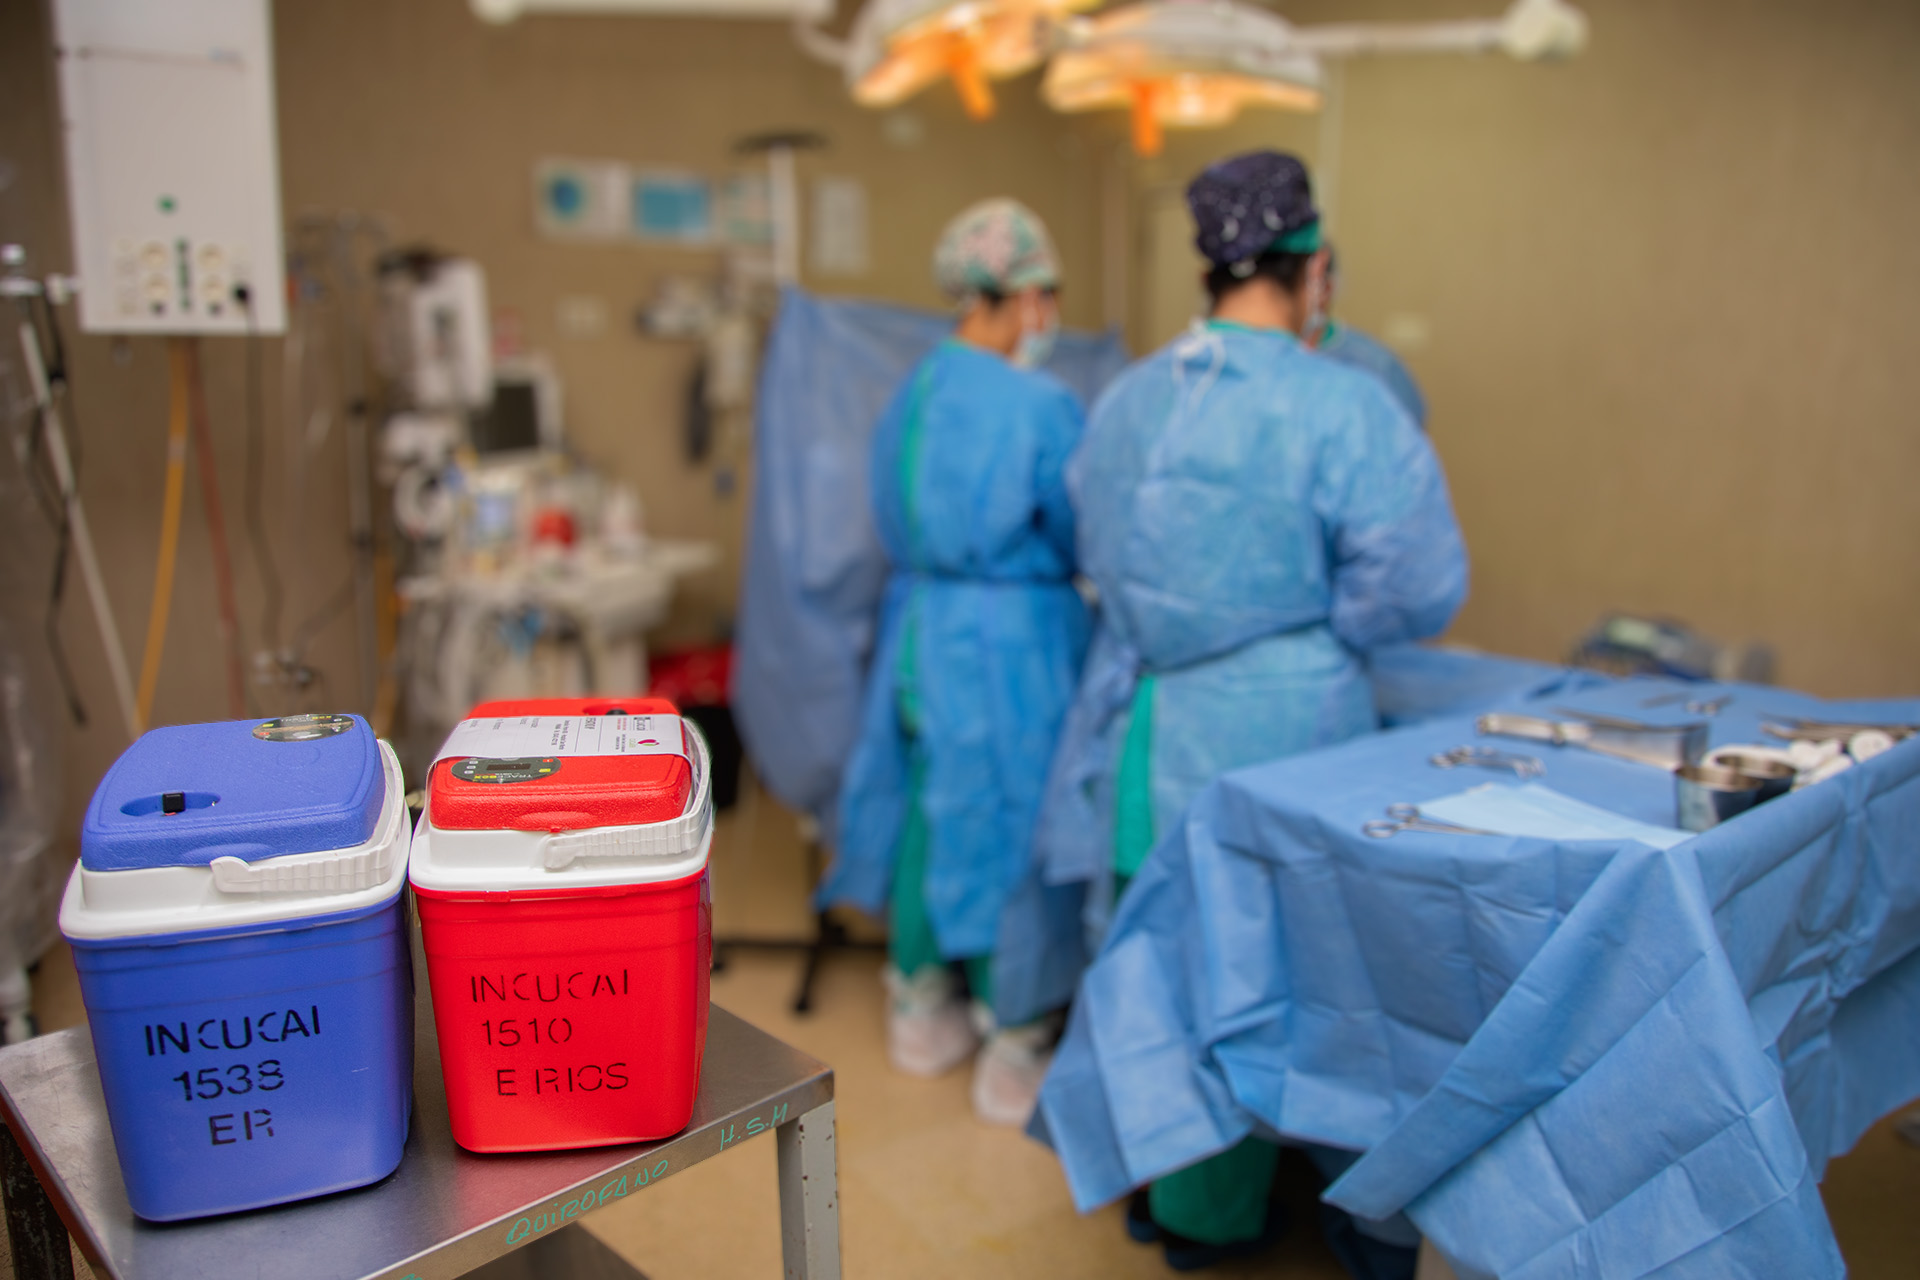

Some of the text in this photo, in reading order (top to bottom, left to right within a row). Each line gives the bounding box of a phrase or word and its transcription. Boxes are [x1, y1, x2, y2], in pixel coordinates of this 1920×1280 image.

[471, 968, 628, 1002] INCUCAI
[145, 1005, 320, 1056] INCUCAI
[482, 1018, 572, 1047] 1510
[173, 1059, 284, 1101] 1538
[497, 1062, 629, 1096] E RIOS
[209, 1109, 274, 1145] ER
